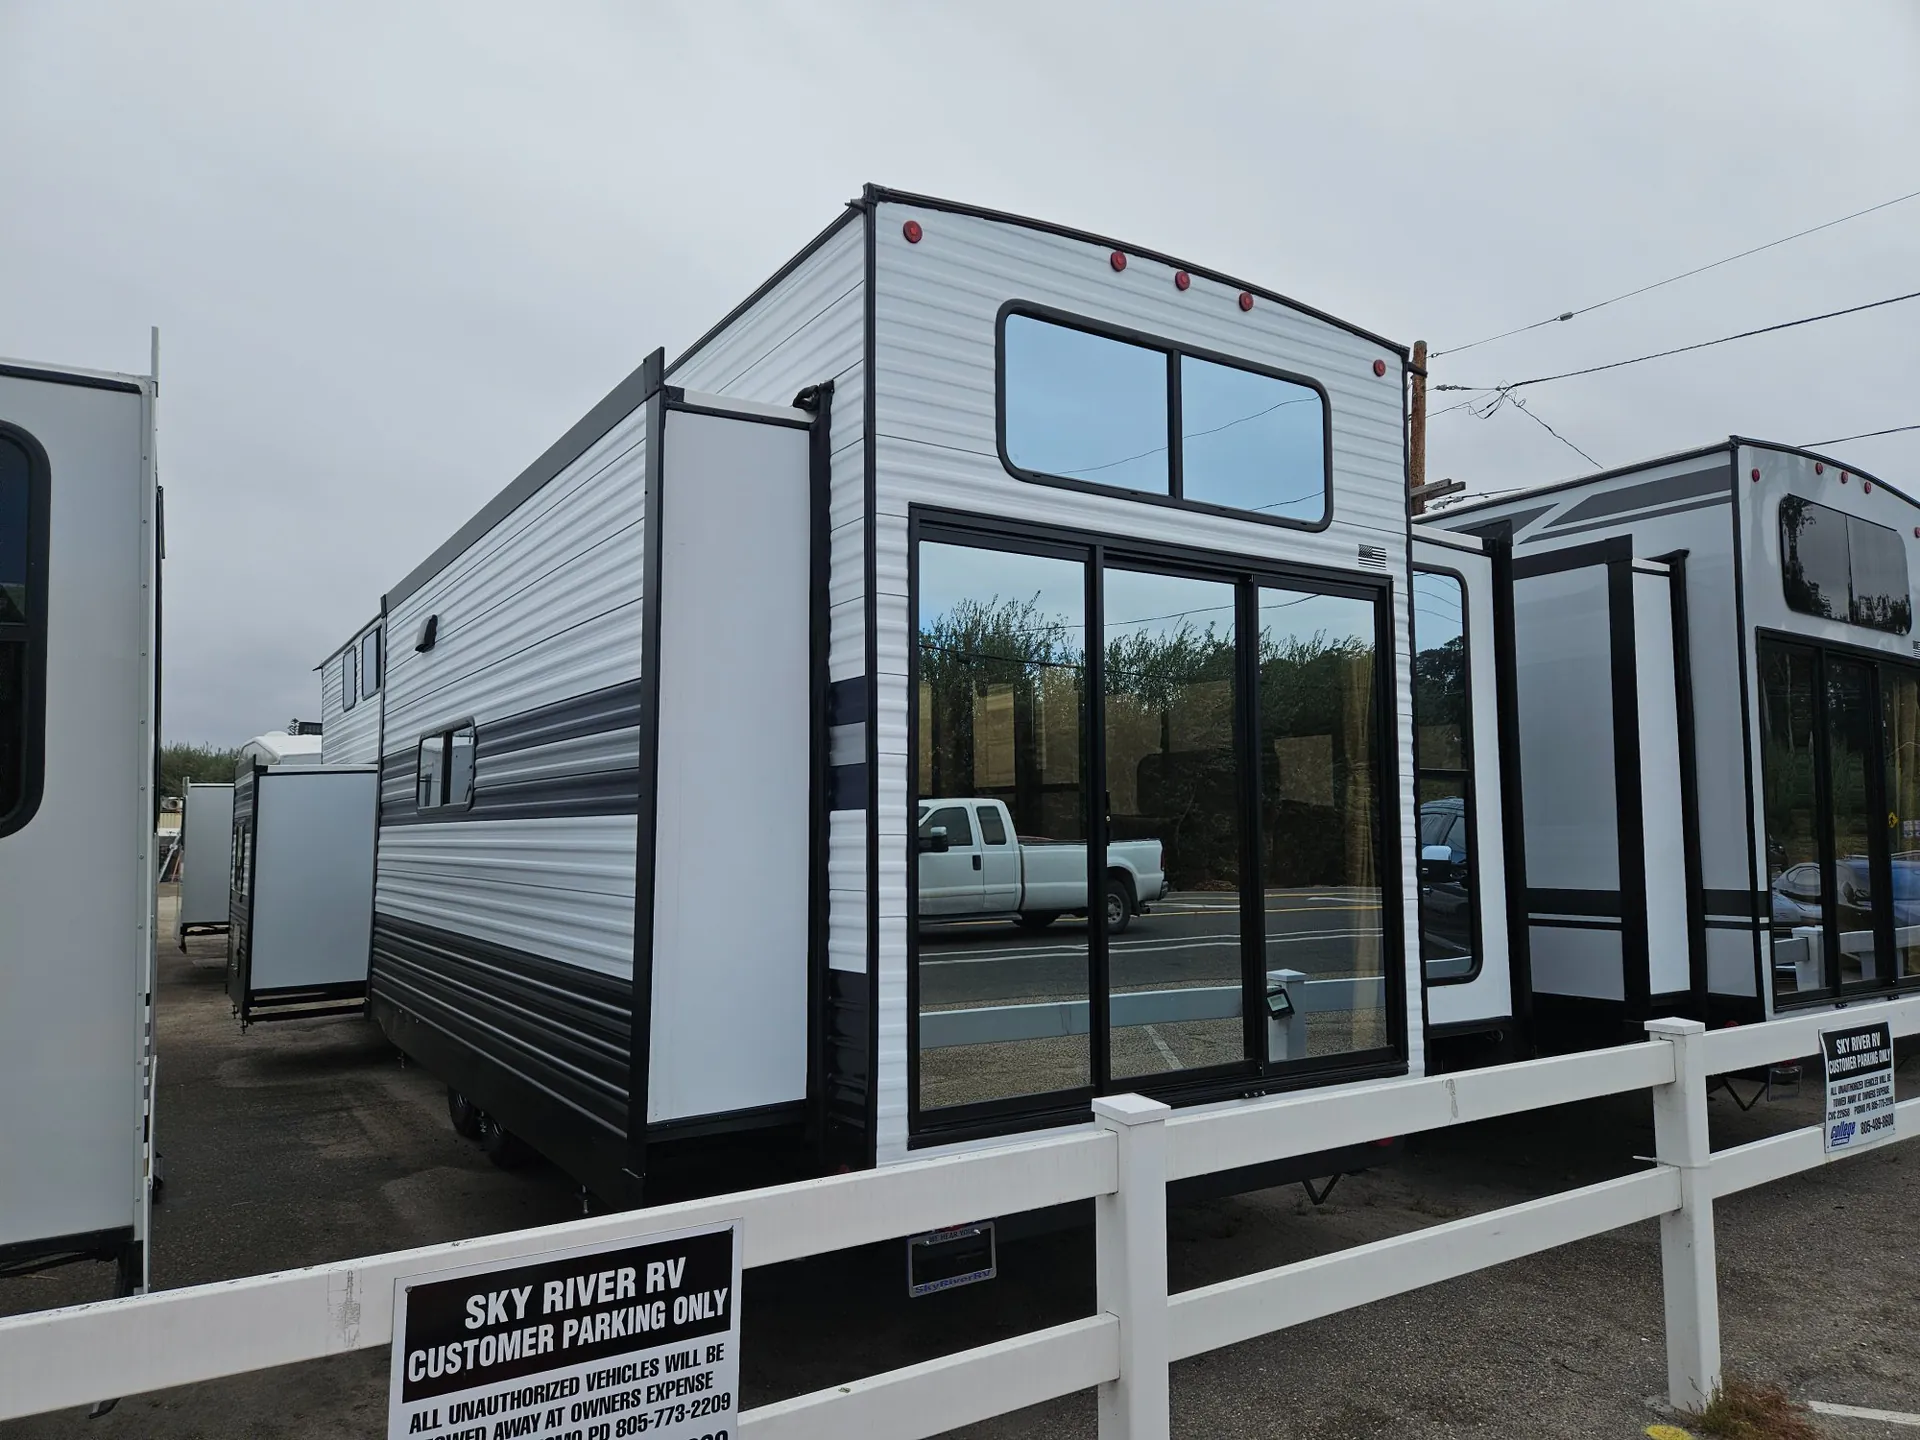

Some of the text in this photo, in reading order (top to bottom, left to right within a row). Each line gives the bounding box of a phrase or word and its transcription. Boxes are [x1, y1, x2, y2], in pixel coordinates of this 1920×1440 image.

[1828, 1048, 1891, 1074] CUSTOMER PARKING ONLY
[1836, 1032, 1880, 1054] SKY RIVER RV
[464, 1256, 687, 1329] SKY RIVER RV
[408, 1287, 729, 1382] CUSTOMER PARKING ONLY
[409, 1408, 442, 1434] ALL
[449, 1377, 580, 1425] UNAUTHORIZED
[586, 1358, 660, 1392] VEHICLES
[664, 1349, 701, 1373] WILL
[705, 1343, 725, 1364] BE
[494, 1412, 542, 1440] AWAY
[545, 1407, 566, 1430] AT
[571, 1388, 641, 1423] OWNERS
[646, 1371, 714, 1404] EXPENSE
[588, 1392, 732, 1440] PD 805-773-2209
